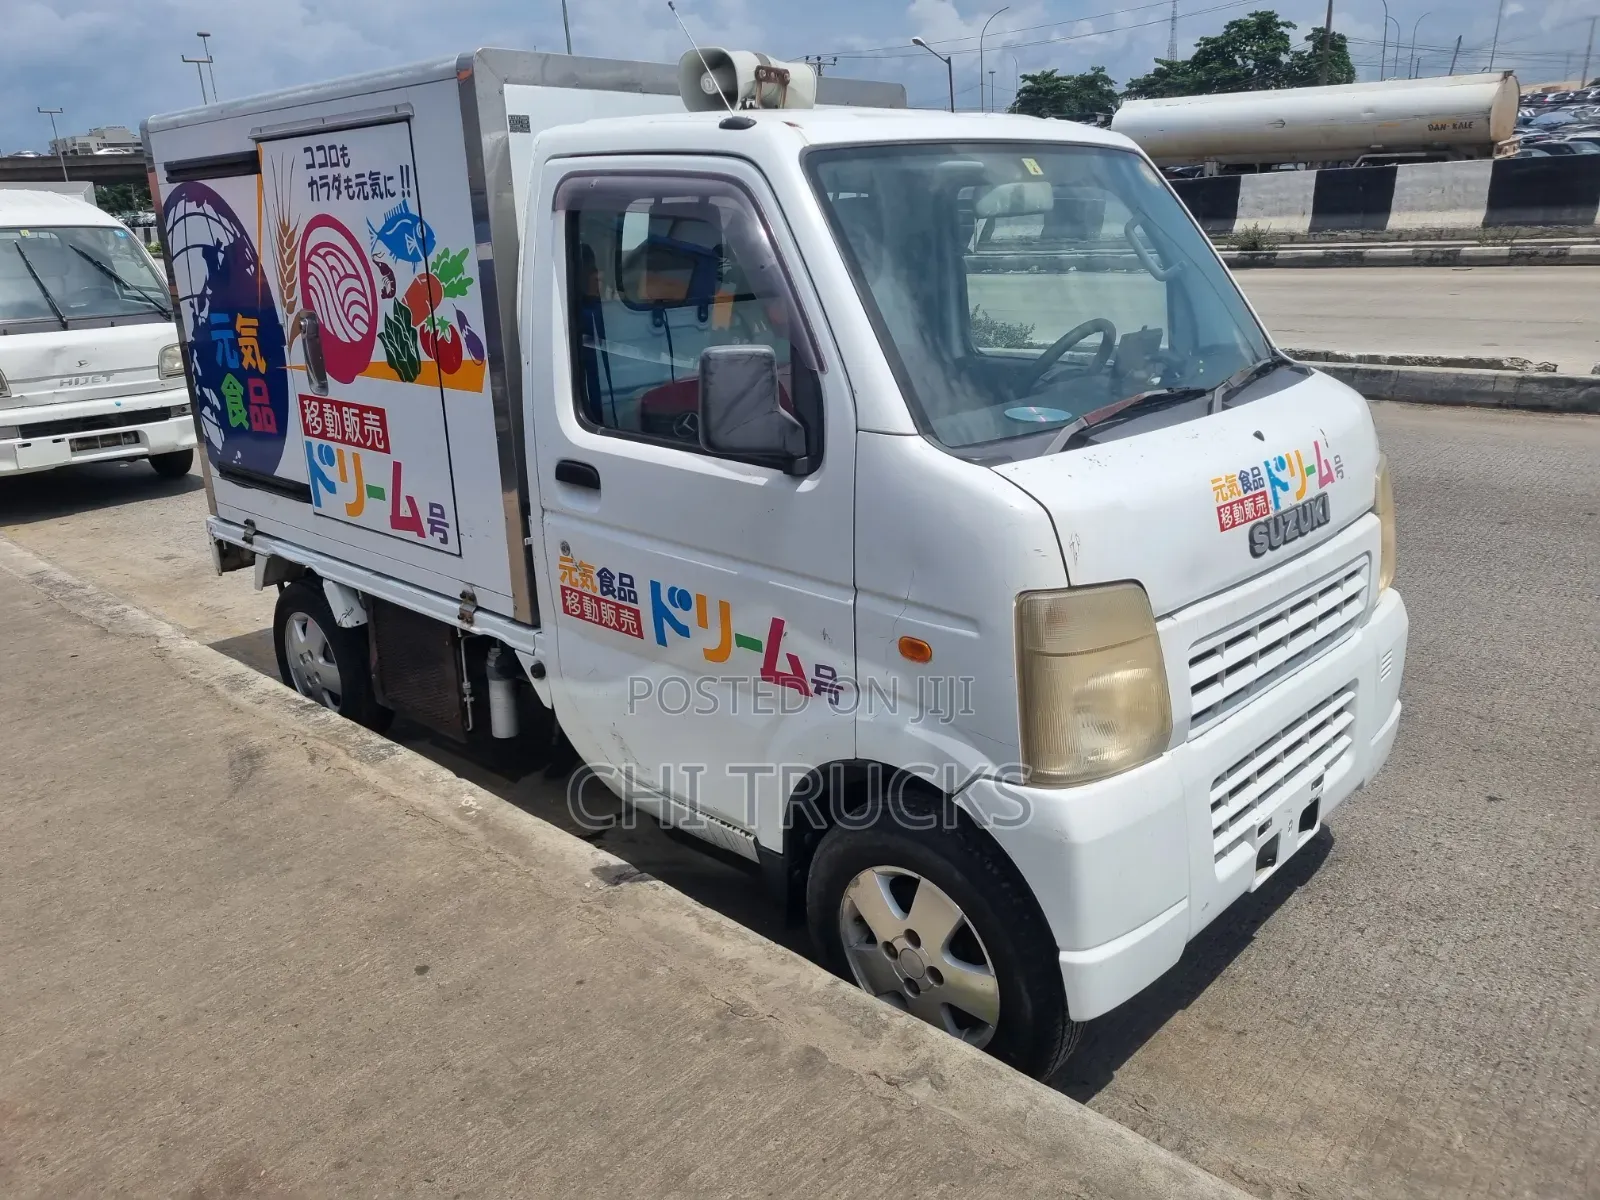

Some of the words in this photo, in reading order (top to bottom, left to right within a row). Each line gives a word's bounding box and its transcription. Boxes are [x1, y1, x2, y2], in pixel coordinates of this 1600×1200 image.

[303, 144, 351, 170] ココロも
[210, 313, 267, 374] 元気
[59, 373, 115, 387] HIJET
[220, 372, 278, 435] 食品
[304, 400, 386, 449] 移動販売
[1211, 466, 1265, 503] 元気食品
[1220, 494, 1268, 529] 移動販売
[1249, 491, 1331, 558] SUZUKI
[558, 556, 639, 606] 元気食品
[564, 589, 641, 638] 移動販売
